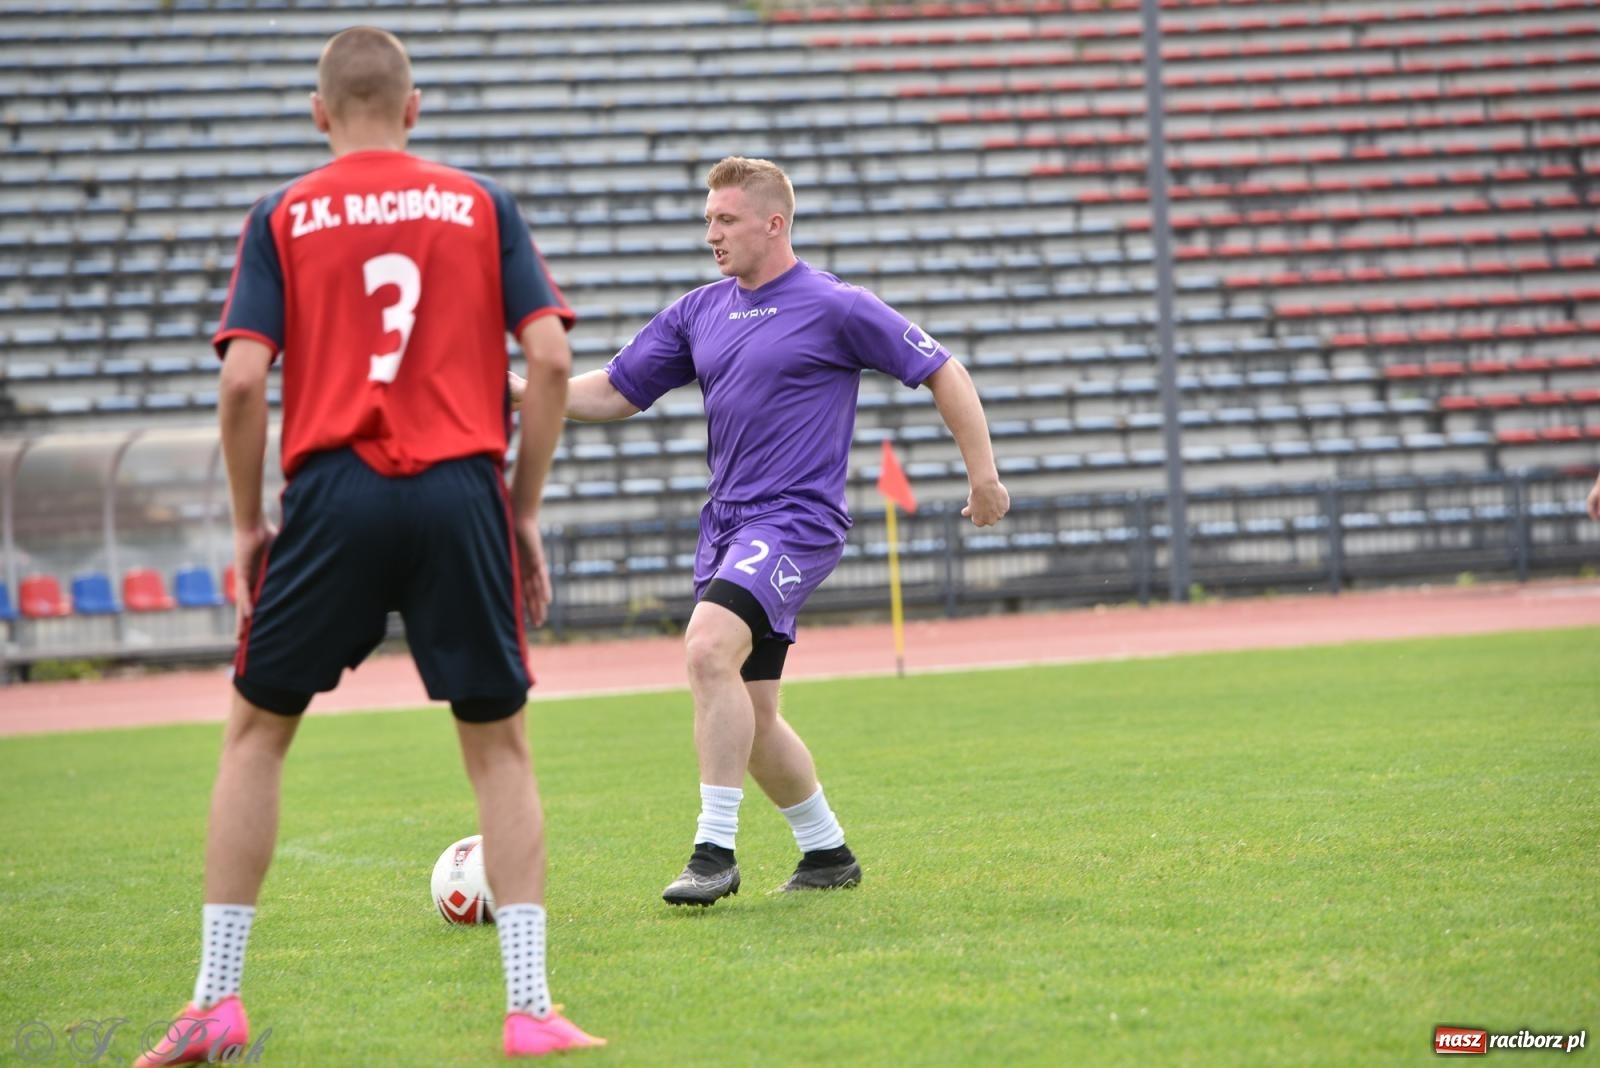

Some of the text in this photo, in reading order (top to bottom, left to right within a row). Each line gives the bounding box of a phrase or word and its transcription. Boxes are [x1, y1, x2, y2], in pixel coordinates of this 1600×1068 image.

[289, 183, 475, 238] Z.K. RACIBÓRZ
[362, 252, 421, 384] 3
[728, 307, 778, 320] GIVOVA
[734, 540, 769, 575] 2
